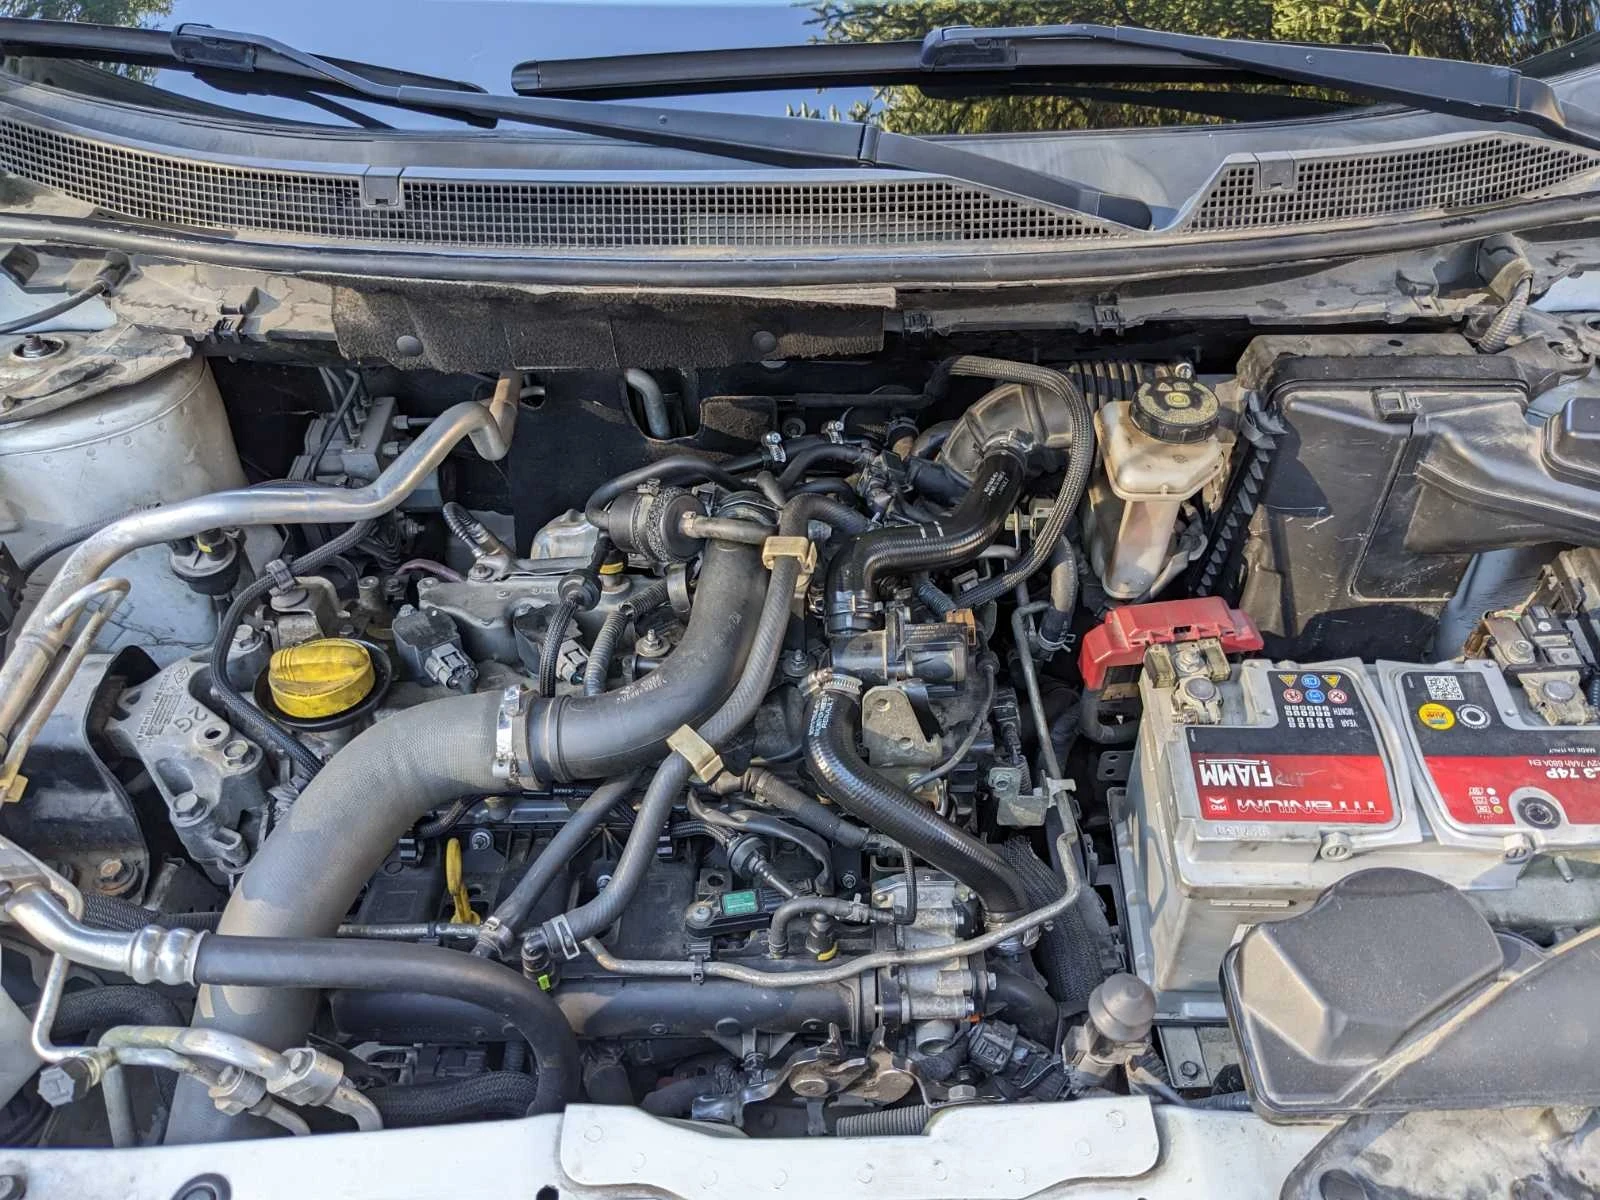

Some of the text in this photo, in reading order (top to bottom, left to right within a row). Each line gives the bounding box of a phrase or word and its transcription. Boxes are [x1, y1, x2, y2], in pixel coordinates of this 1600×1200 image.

[1332, 707, 1355, 716] MONTH
[1340, 718, 1358, 728] YEAR
[1199, 763, 1274, 788] FIAMM
[1546, 767, 1580, 779] 74P
